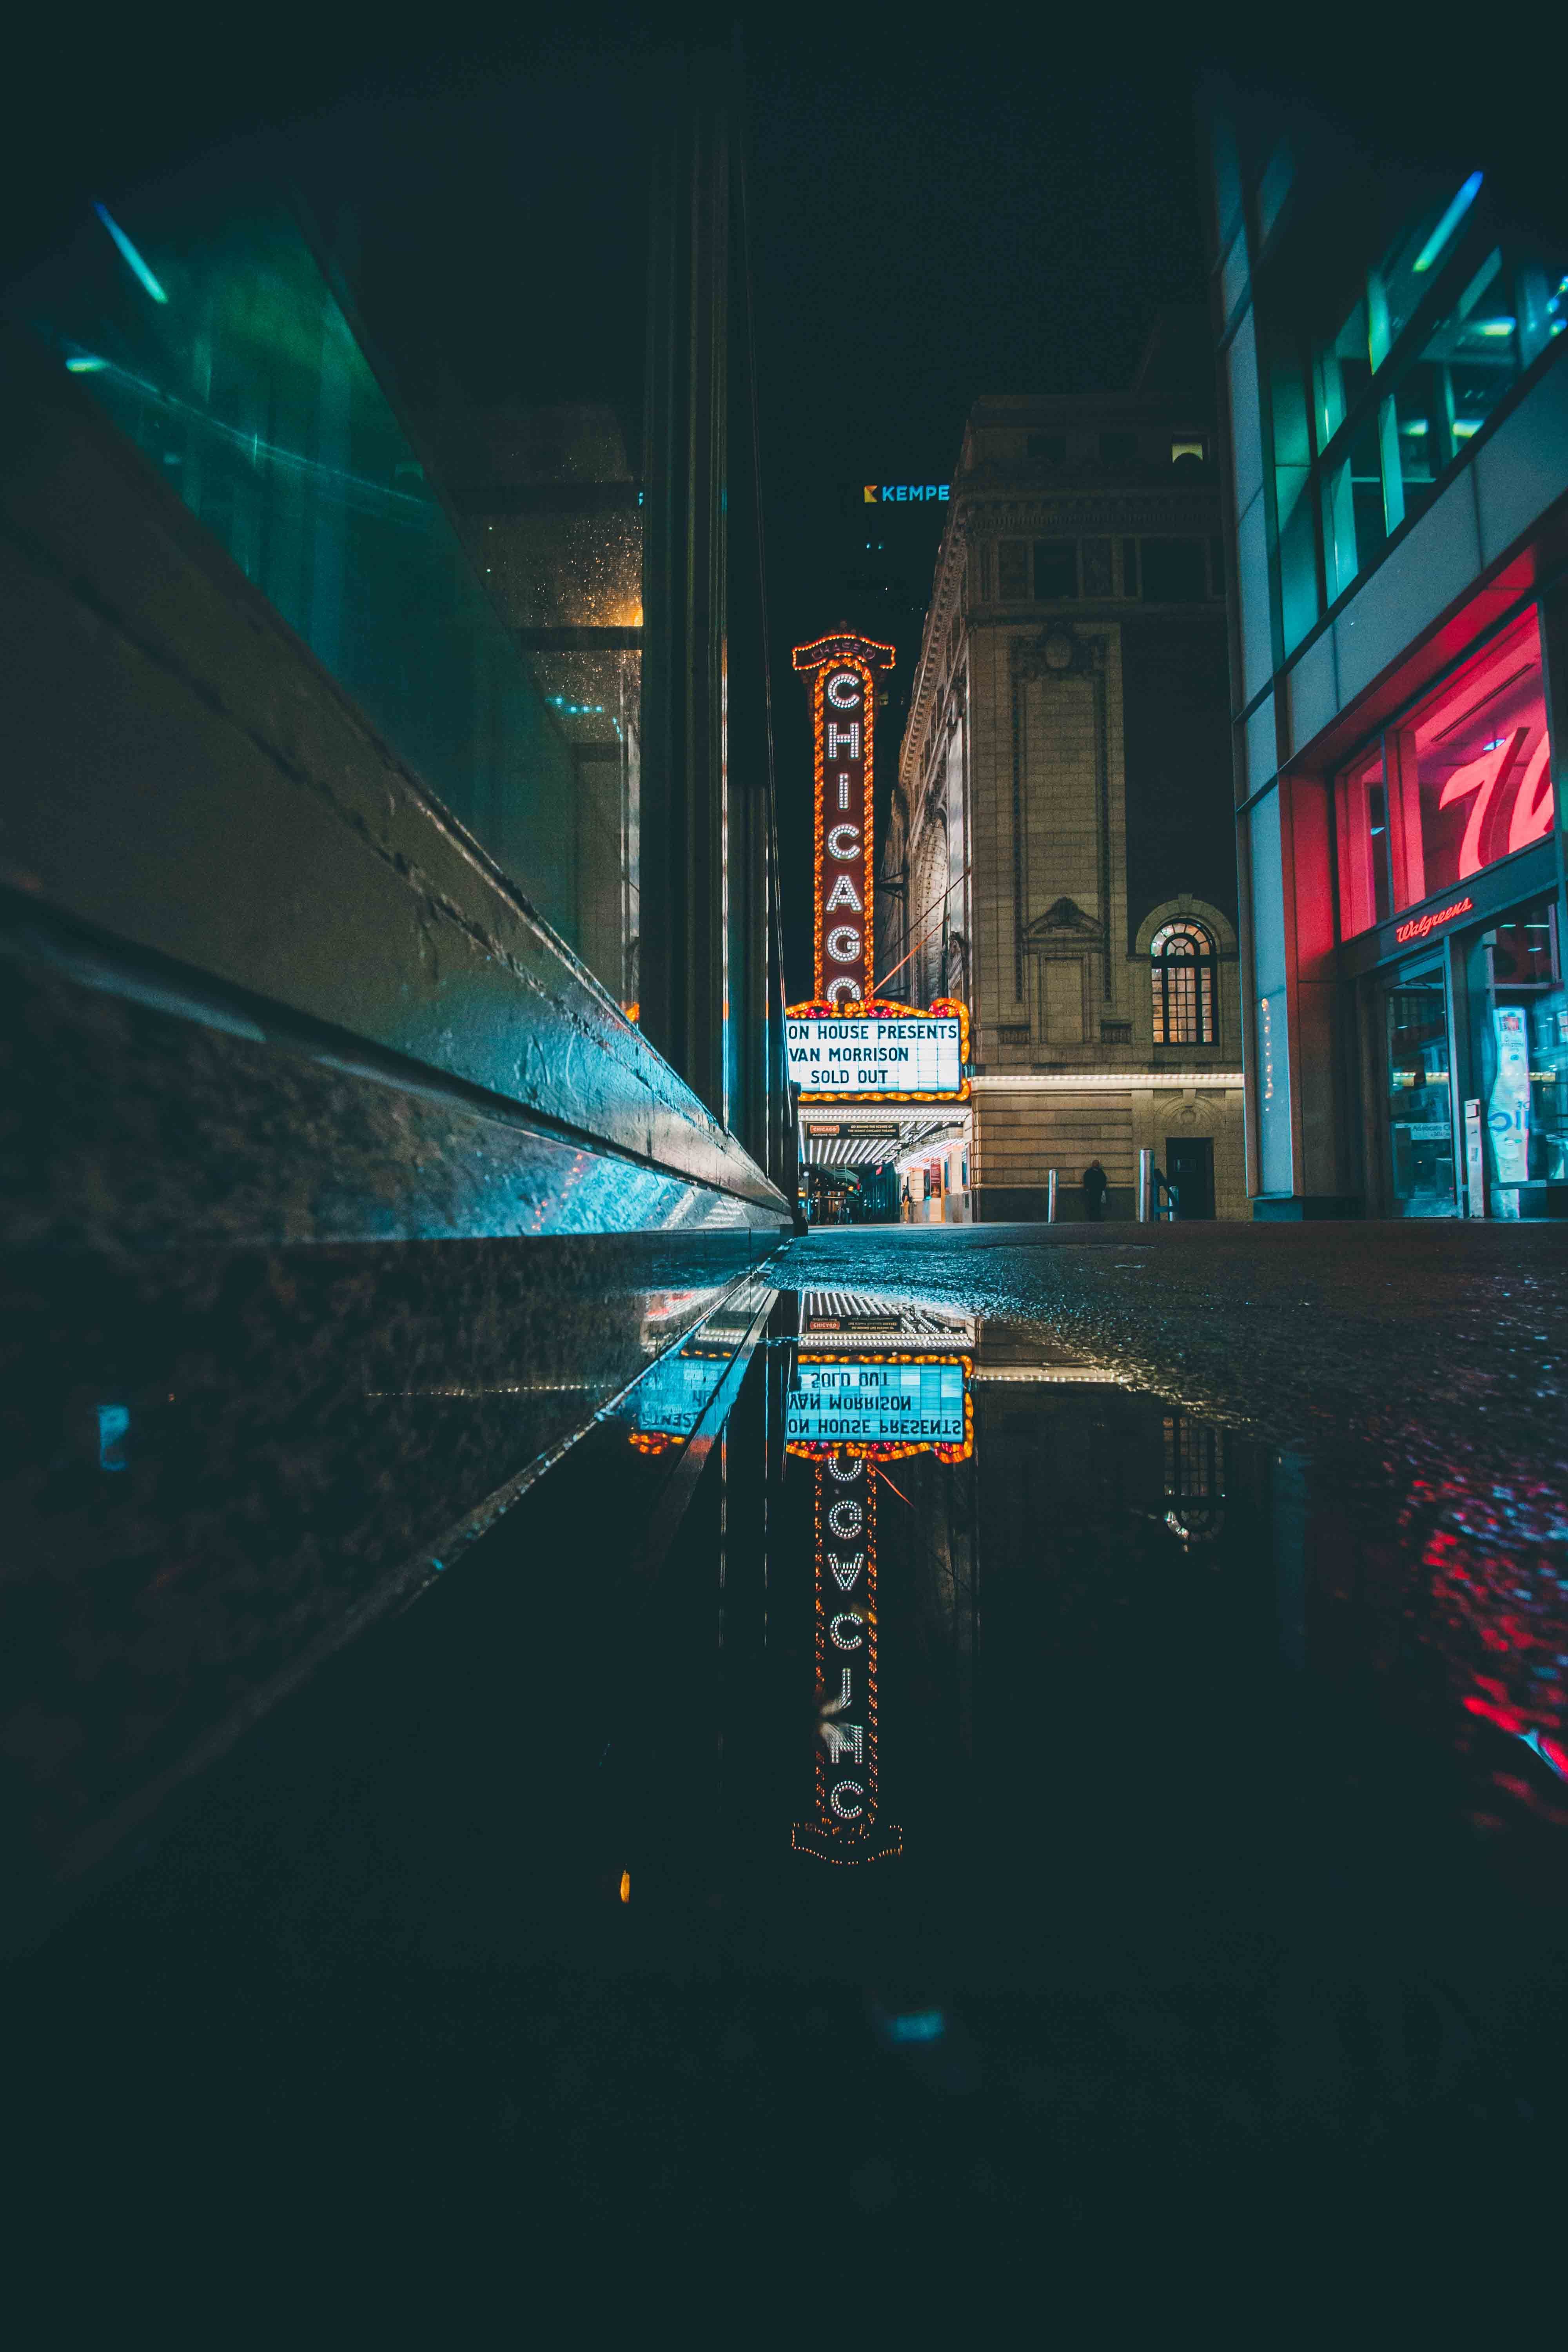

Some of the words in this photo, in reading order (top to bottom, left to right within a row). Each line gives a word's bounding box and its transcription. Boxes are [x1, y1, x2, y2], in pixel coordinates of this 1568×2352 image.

[882, 485, 950, 501] KEMPE
[1396, 897, 1473, 943] Walgreens
[789, 1025, 809, 1039] ON
[818, 1025, 868, 1039] HOUSE
[878, 1025, 957, 1039] PRESENTS
[789, 1048, 820, 1062] VAN
[829, 1047, 908, 1062] MORRISON
[811, 1070, 849, 1083] SOLD
[858, 1070, 888, 1083] OUT
